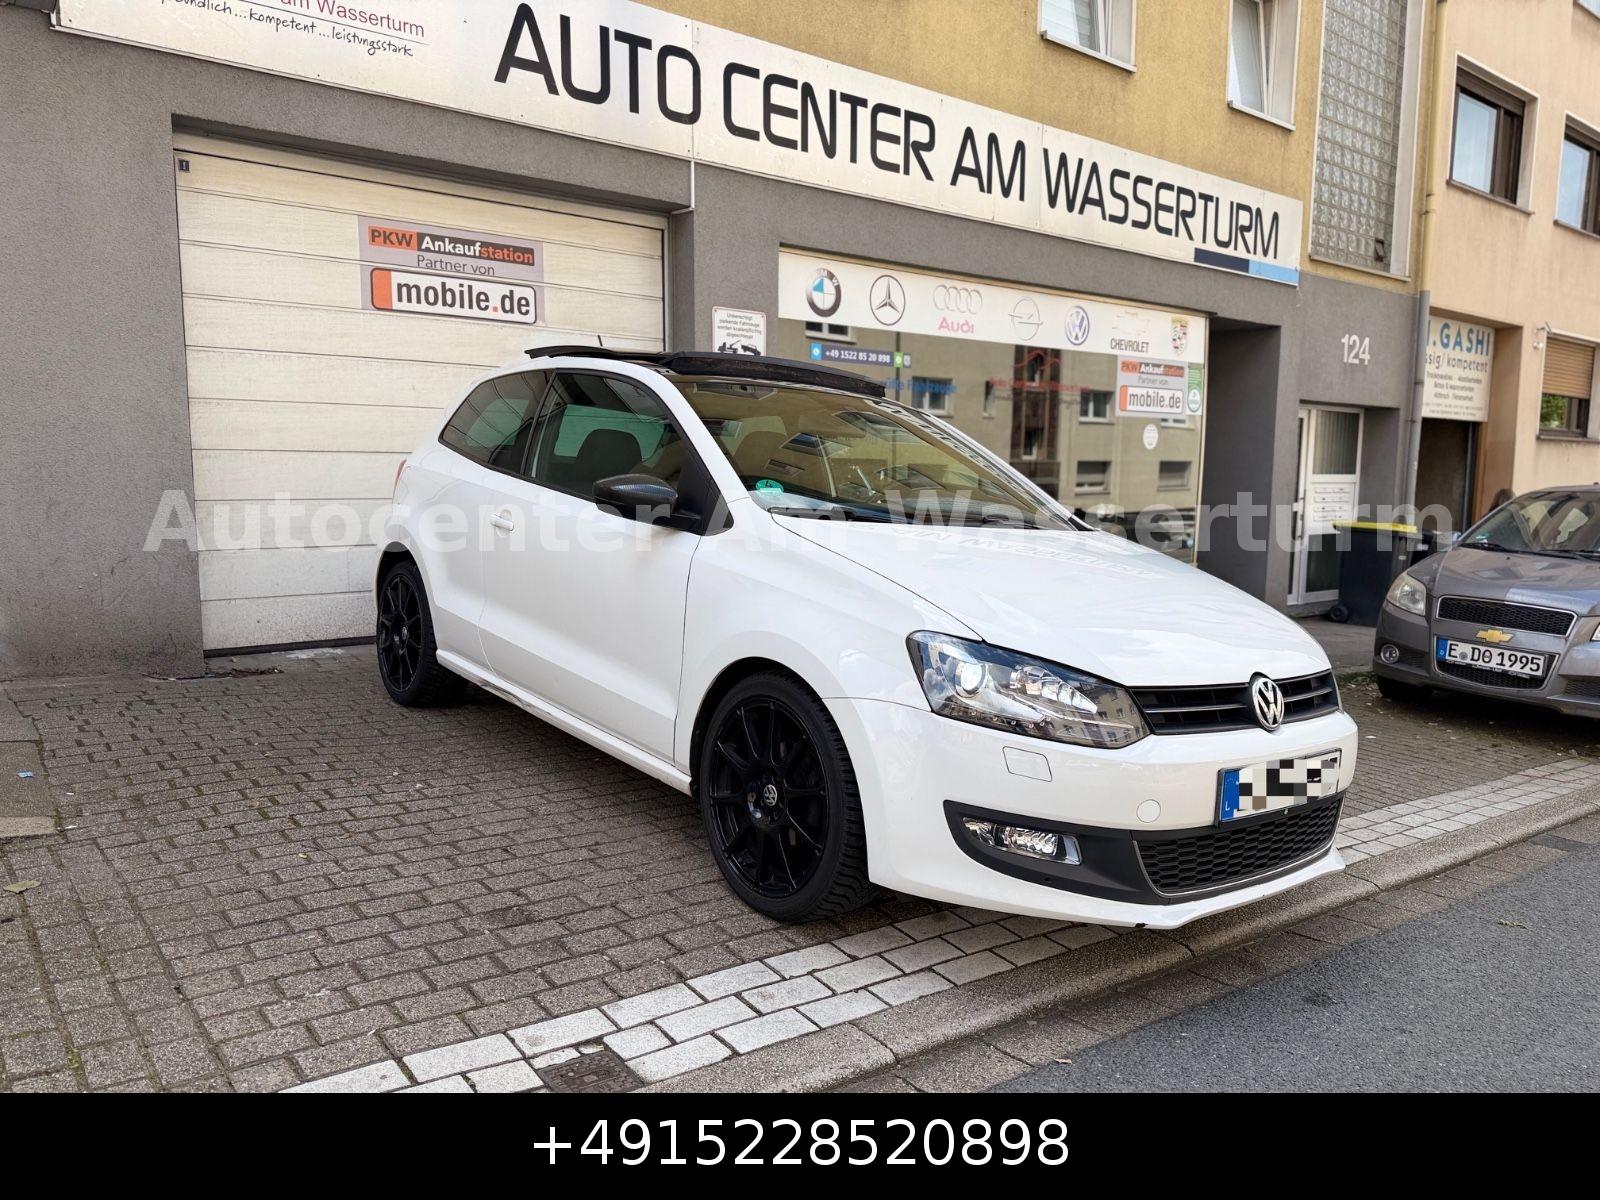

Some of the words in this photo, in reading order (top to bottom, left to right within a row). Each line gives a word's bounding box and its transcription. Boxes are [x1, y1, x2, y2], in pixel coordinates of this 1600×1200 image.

[318, 0, 425, 37] Wasserturm
[494, 3, 701, 125] AUTO
[723, 62, 936, 182] CENTER
[950, 126, 1026, 201] AM
[1043, 148, 1280, 259] WASSERTURM
[371, 229, 413, 247] PKW
[421, 236, 533, 264] Ankaufstation
[417, 255, 468, 273] Partner
[470, 265, 495, 277] von
[397, 281, 531, 316] mobile.de
[937, 316, 975, 334] Audi
[825, 349, 839, 358] +49
[841, 351, 857, 360] 1522
[858, 352, 868, 361] 85
[868, 353, 877, 361] 20
[878, 354, 891, 363] 898
[1110, 338, 1150, 353] CHEVROLET
[1341, 334, 1371, 365] 124
[1129, 390, 1181, 409] mobile.de
[1448, 643, 1459, 659] E
[1496, 652, 1542, 672] 1995
